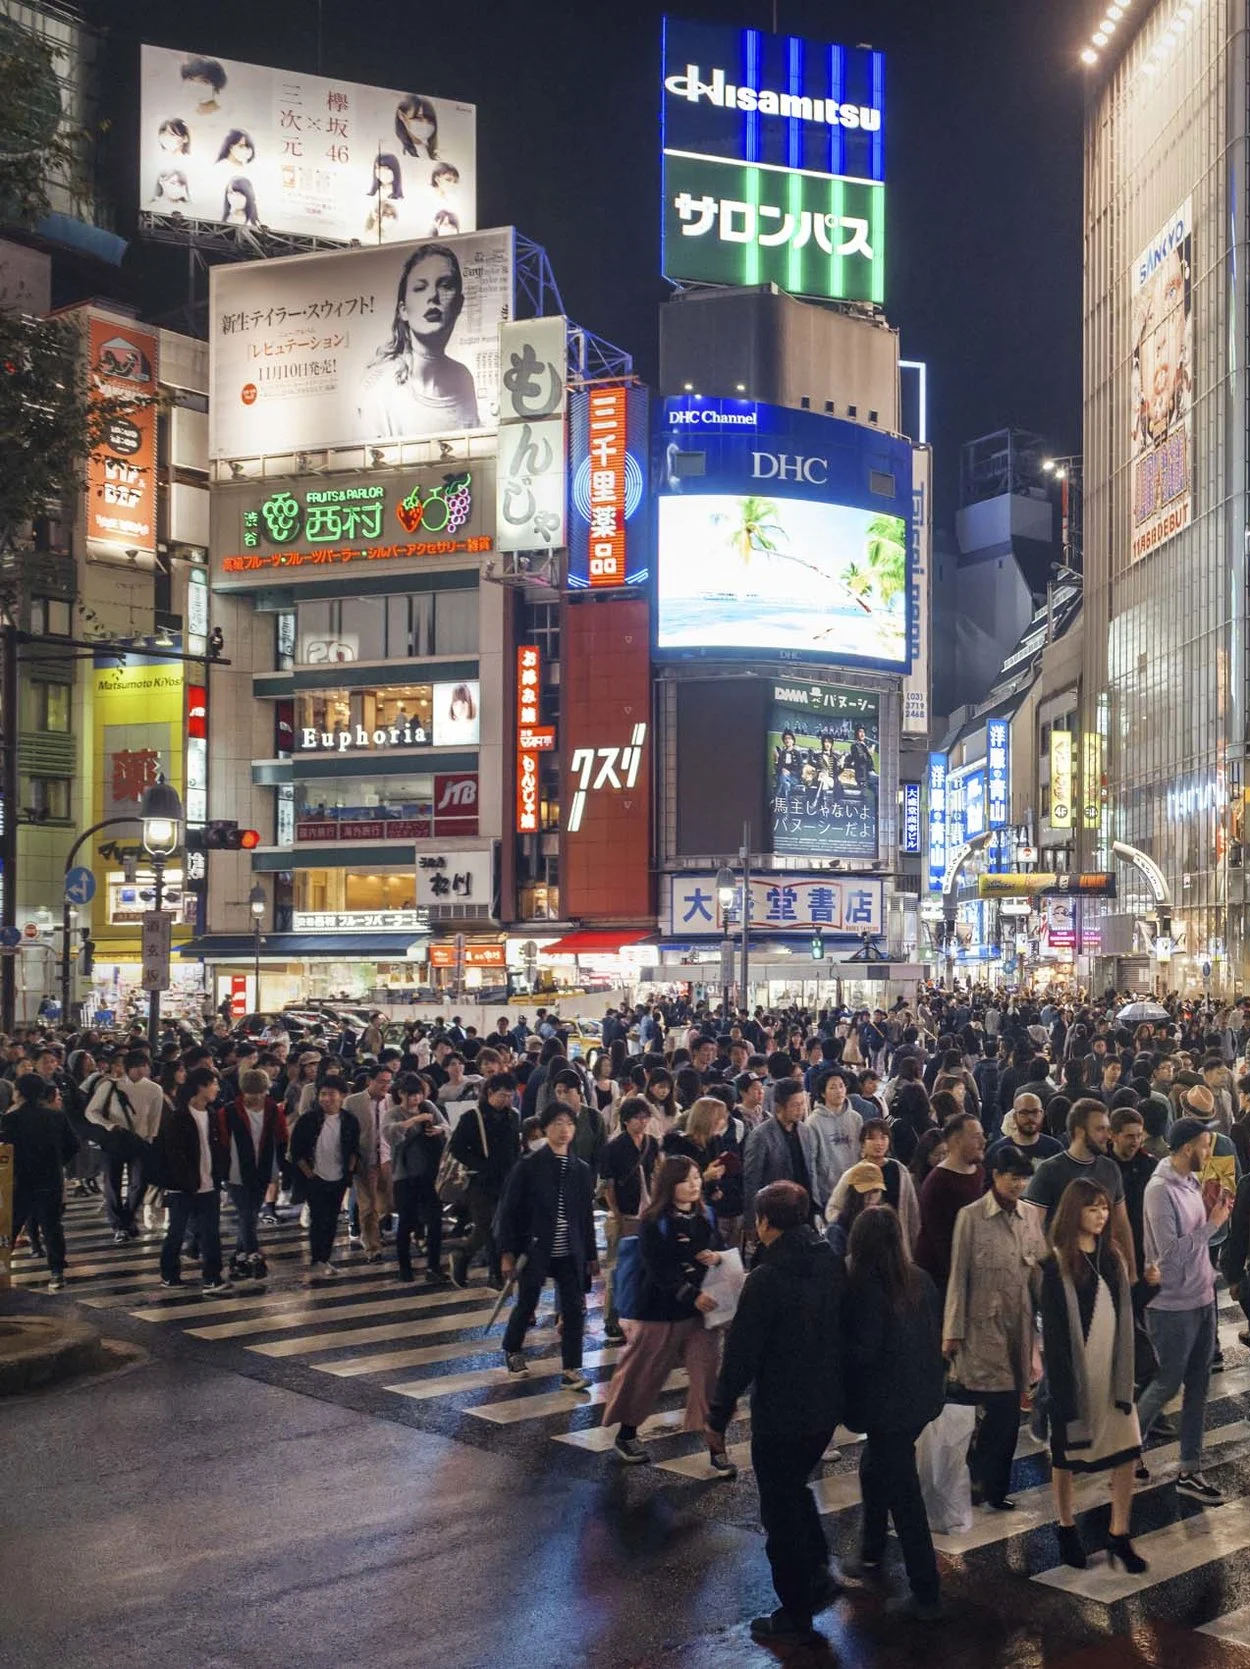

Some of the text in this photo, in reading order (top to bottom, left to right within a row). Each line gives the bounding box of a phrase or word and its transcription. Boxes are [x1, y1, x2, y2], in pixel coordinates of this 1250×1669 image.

[665, 64, 881, 131] Hisamitsu
[279, 83, 302, 157] 三次元
[326, 91, 349, 163] 欅坂46
[675, 193, 873, 260] サロンパス
[1140, 220, 1183, 284] SANKYO
[669, 411, 757, 425] DHC Channel
[590, 396, 616, 574] 三千里薬品
[752, 452, 828, 484] DHC
[306, 502, 383, 542] 西村
[98, 680, 152, 690] Matsumoto
[775, 686, 808, 703] DMM
[907, 692, 923, 700] (03)
[301, 724, 427, 752] Euphoria
[568, 722, 646, 832] クスリ
[990, 724, 1008, 822] 洋服の青山
[438, 780, 477, 810] JTB
[1055, 807, 1067, 816] 4F
[430, 872, 471, 896] 松川
